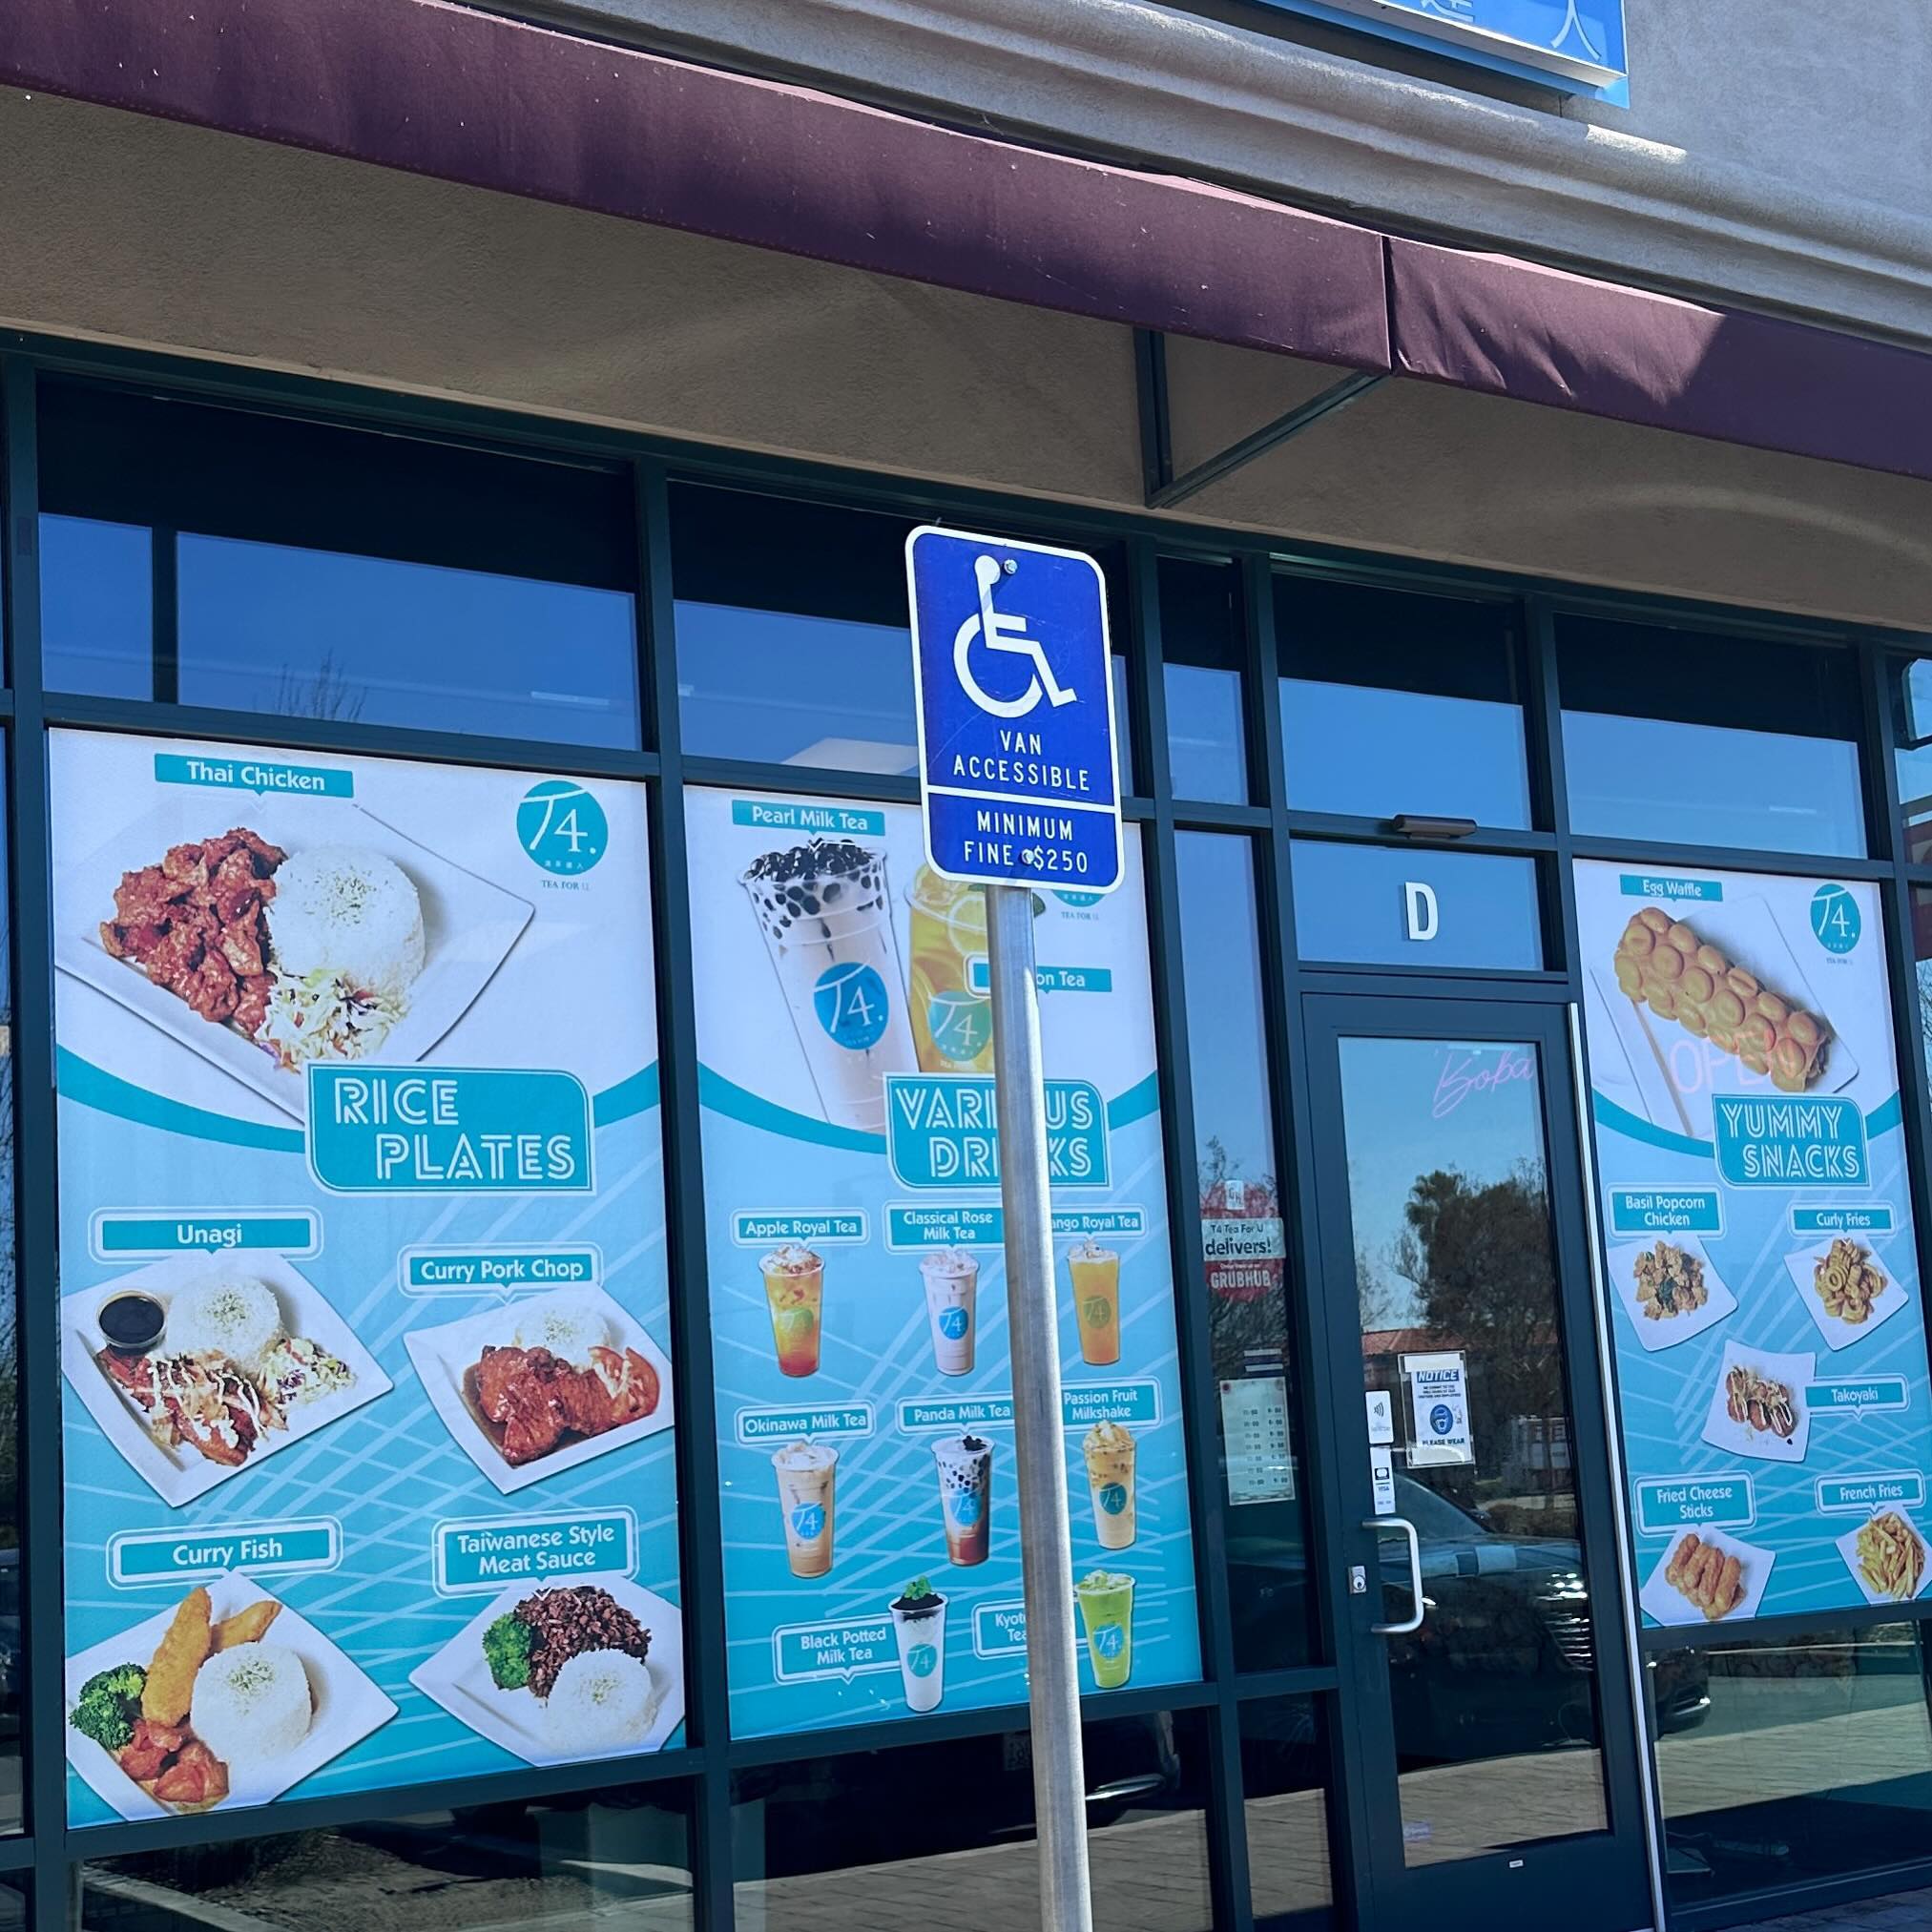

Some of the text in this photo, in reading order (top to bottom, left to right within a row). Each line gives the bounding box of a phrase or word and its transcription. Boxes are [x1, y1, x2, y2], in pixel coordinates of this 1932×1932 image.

[1000, 729, 1042, 757] VAN
[186, 760, 325, 791] Thai Chicken
[953, 755, 1091, 792] ACCESSIBLE
[752, 805, 868, 831] Pearl Milk Tea
[977, 810, 1074, 841] MINIMUM
[964, 840, 1088, 873] FINE $250
[1642, 879, 1702, 898] Egg Waffle
[1404, 882, 1439, 941] D
[1058, 970, 1086, 987] Tea
[334, 1077, 461, 1125] RICE
[895, 1088, 1094, 1132] VARIUS
[1720, 1103, 1843, 1140] YUMMY
[376, 1133, 575, 1181] PLATES
[928, 1136, 1092, 1178] DRIKS
[1742, 1144, 1860, 1179] SNACKS
[1625, 1195, 1706, 1212] Basil Popcorn
[903, 1210, 993, 1225] Classical Rose
[1082, 1215, 1115, 1231] Royal
[1117, 1215, 1139, 1229] Tea
[1644, 1212, 1691, 1226] Chicken
[1816, 1212, 1871, 1229] Curly Fries
[176, 1222, 243, 1248] Unagi
[745, 1219, 858, 1237] Apple Royal Tea
[923, 1226, 977, 1240] Milk Tea
[1224, 1224, 1239, 1234] Tea
[1241, 1223, 1254, 1234] For
[1205, 1236, 1272, 1256] delivers!
[421, 1258, 585, 1283] Curry Pork Chop
[1210, 1270, 1272, 1289] GRUBHUB
[1418, 1369, 1458, 1382] NOTICE
[1064, 1388, 1138, 1405] Passion Fruit
[1831, 1386, 1879, 1403] Takoyaki
[914, 1403, 1011, 1422] Panda Milk Tea
[1071, 1404, 1132, 1421] Milkshake
[745, 1413, 866, 1434] Okinawa Milk Tea
[1656, 1485, 1733, 1504] Fried Cheese
[1839, 1484, 1904, 1501] French Fries
[1679, 1503, 1714, 1519] Sticks
[569, 1524, 615, 1548] Style
[173, 1538, 283, 1566] Curry Fish
[479, 1551, 596, 1575] Meat Sauce
[995, 1612, 1027, 1629] Kyot
[800, 1627, 887, 1650] Black Potted
[817, 1647, 873, 1666] Milk Tea
